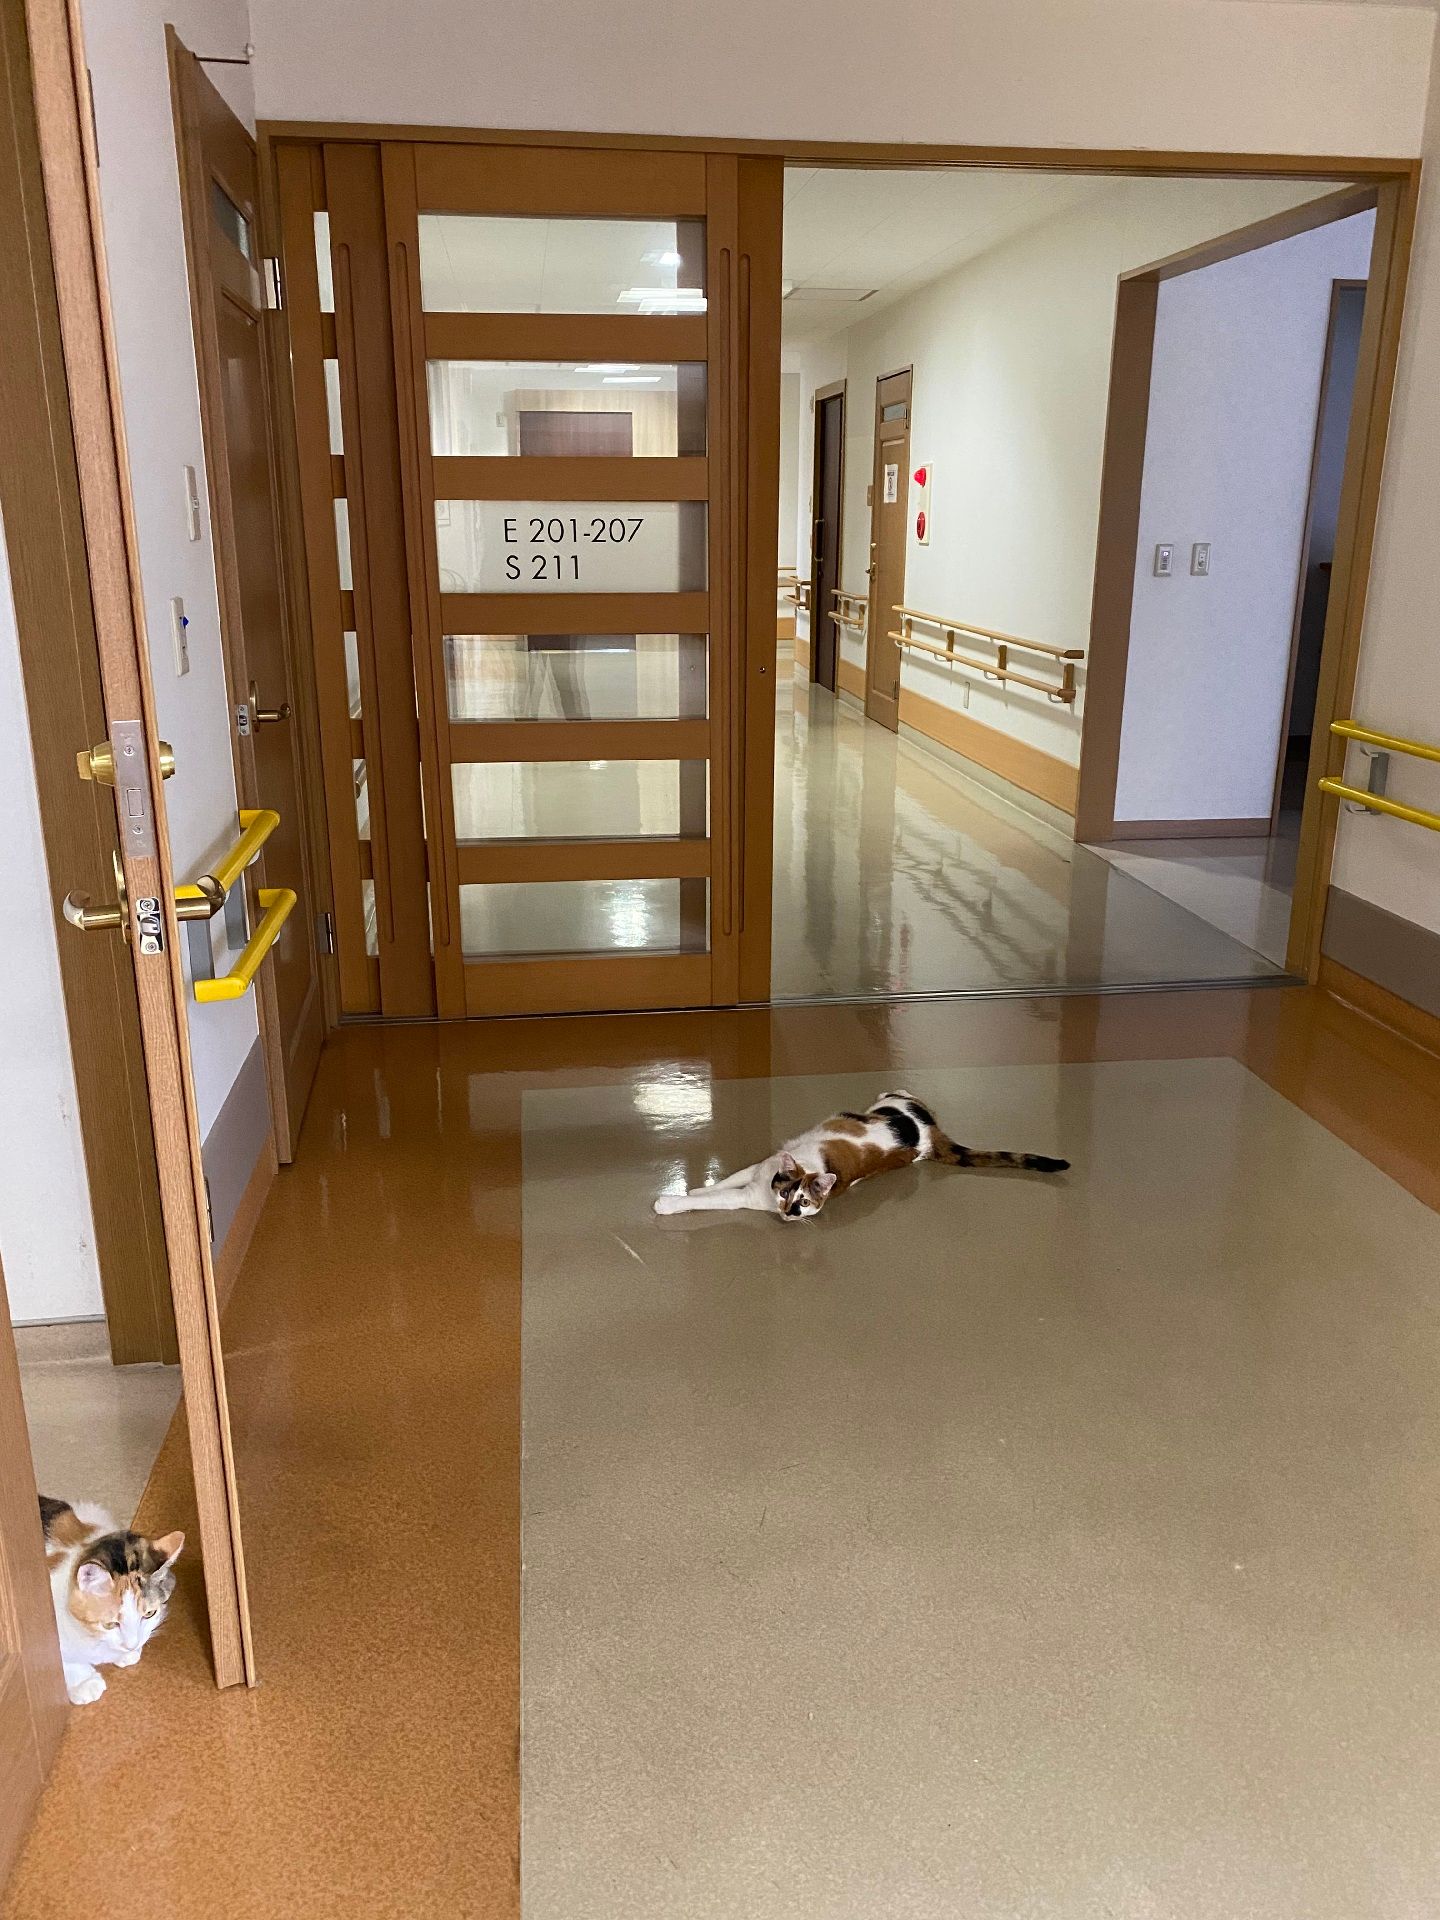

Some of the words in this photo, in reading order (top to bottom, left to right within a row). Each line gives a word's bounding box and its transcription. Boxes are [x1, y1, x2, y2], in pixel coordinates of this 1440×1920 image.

[503, 518, 518, 543] E
[529, 518, 645, 543] 201-207
[505, 554, 521, 580] S
[531, 554, 580, 580] 211
